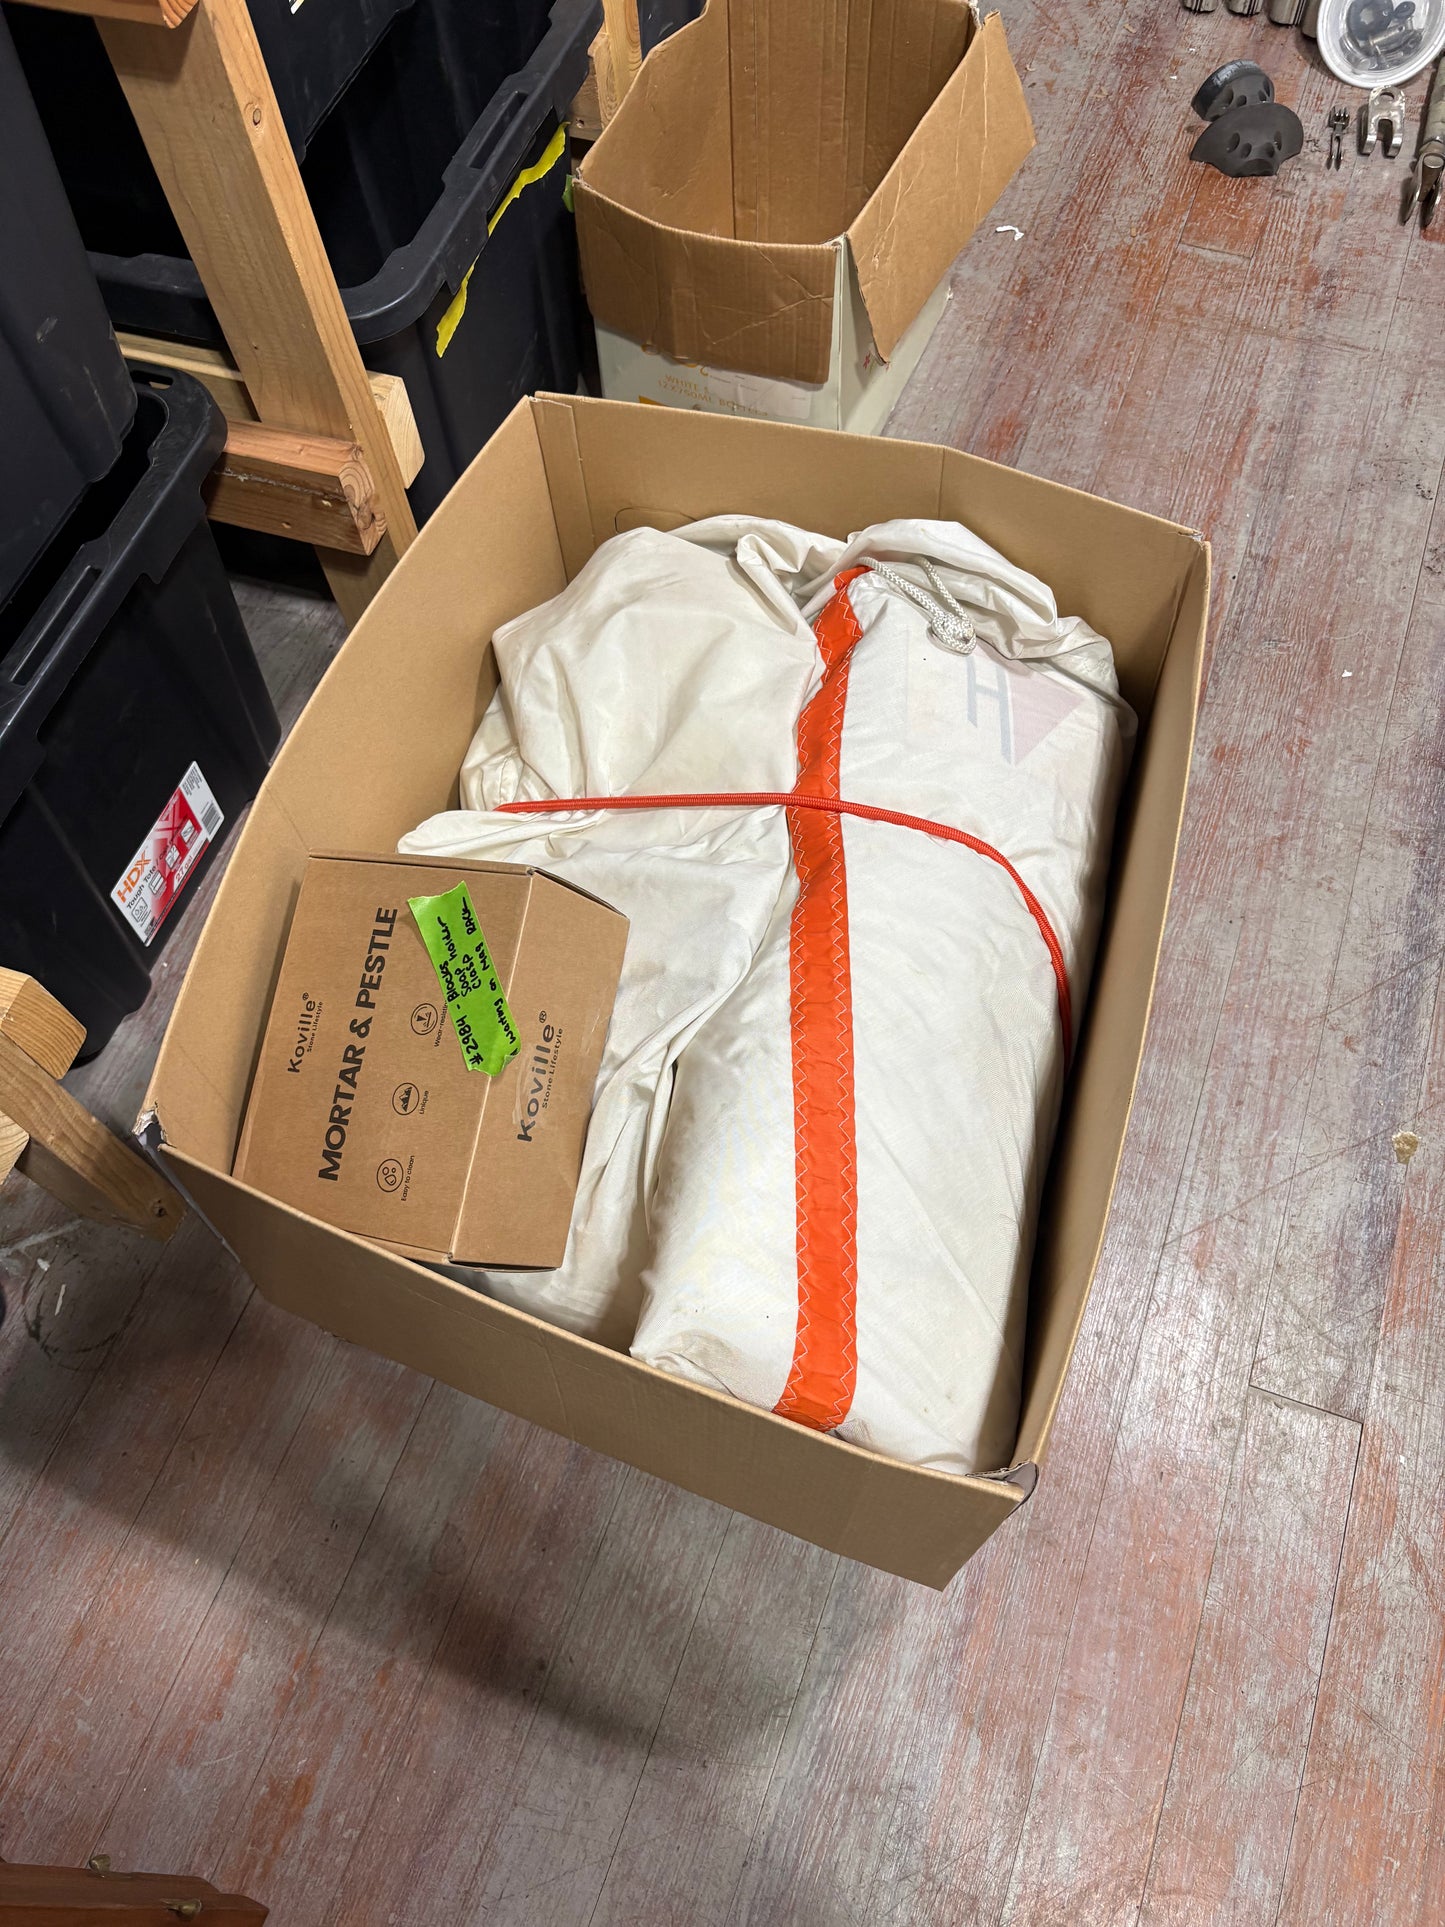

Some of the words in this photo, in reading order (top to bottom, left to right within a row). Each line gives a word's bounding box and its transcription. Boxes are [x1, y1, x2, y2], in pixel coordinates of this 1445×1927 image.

[117, 850, 151, 903] HDX
[127, 884, 145, 909] Tough
[144, 866, 157, 883] Tote
[176, 868, 184, 882] 27
[355, 907, 398, 1009] PESTLE
[437, 916, 458, 962] holder
[439, 960, 460, 1003] Blocks
[455, 967, 473, 998] Soap
[307, 1033, 315, 1053] Stone
[312, 1001, 324, 1032] Lifestyle
[349, 1015, 373, 1039] &
[433, 1000, 449, 1048] Wear-resistin
[456, 1014, 485, 1066] #2984
[541, 1077, 553, 1109] Stone
[549, 1027, 564, 1075] Lifestyle
[318, 1043, 366, 1182] MORTAR
[419, 1090, 429, 1115] Unique
[401, 1184, 410, 1202] Easy
[407, 1155, 415, 1174] clean
